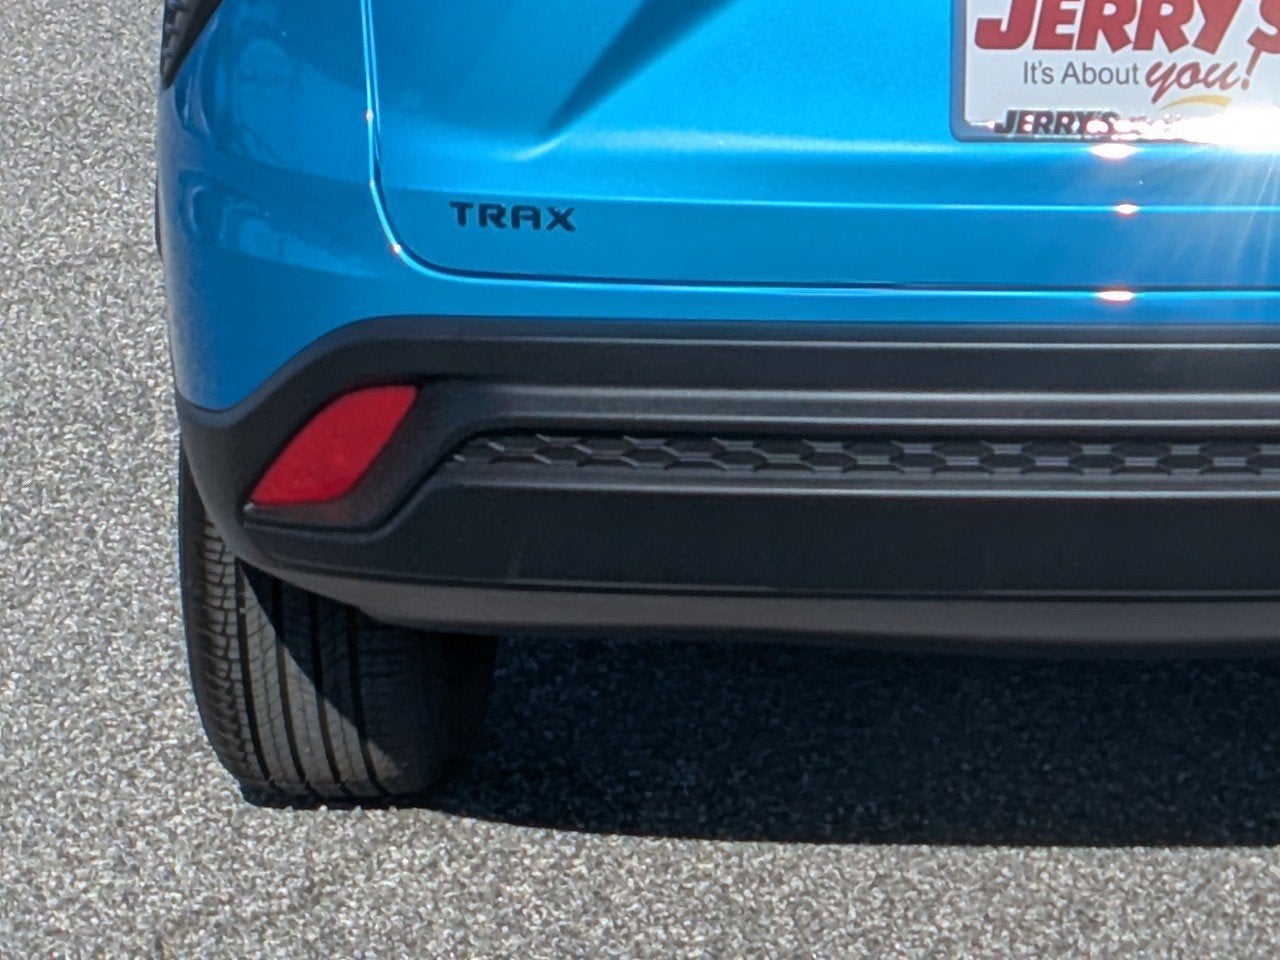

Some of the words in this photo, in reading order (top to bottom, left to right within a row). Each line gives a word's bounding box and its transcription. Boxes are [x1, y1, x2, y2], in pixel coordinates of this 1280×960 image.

[1023, 60, 1055, 85] It's
[1061, 60, 1140, 85] About
[1144, 48, 1263, 105] you!
[448, 200, 577, 232] TRAX
